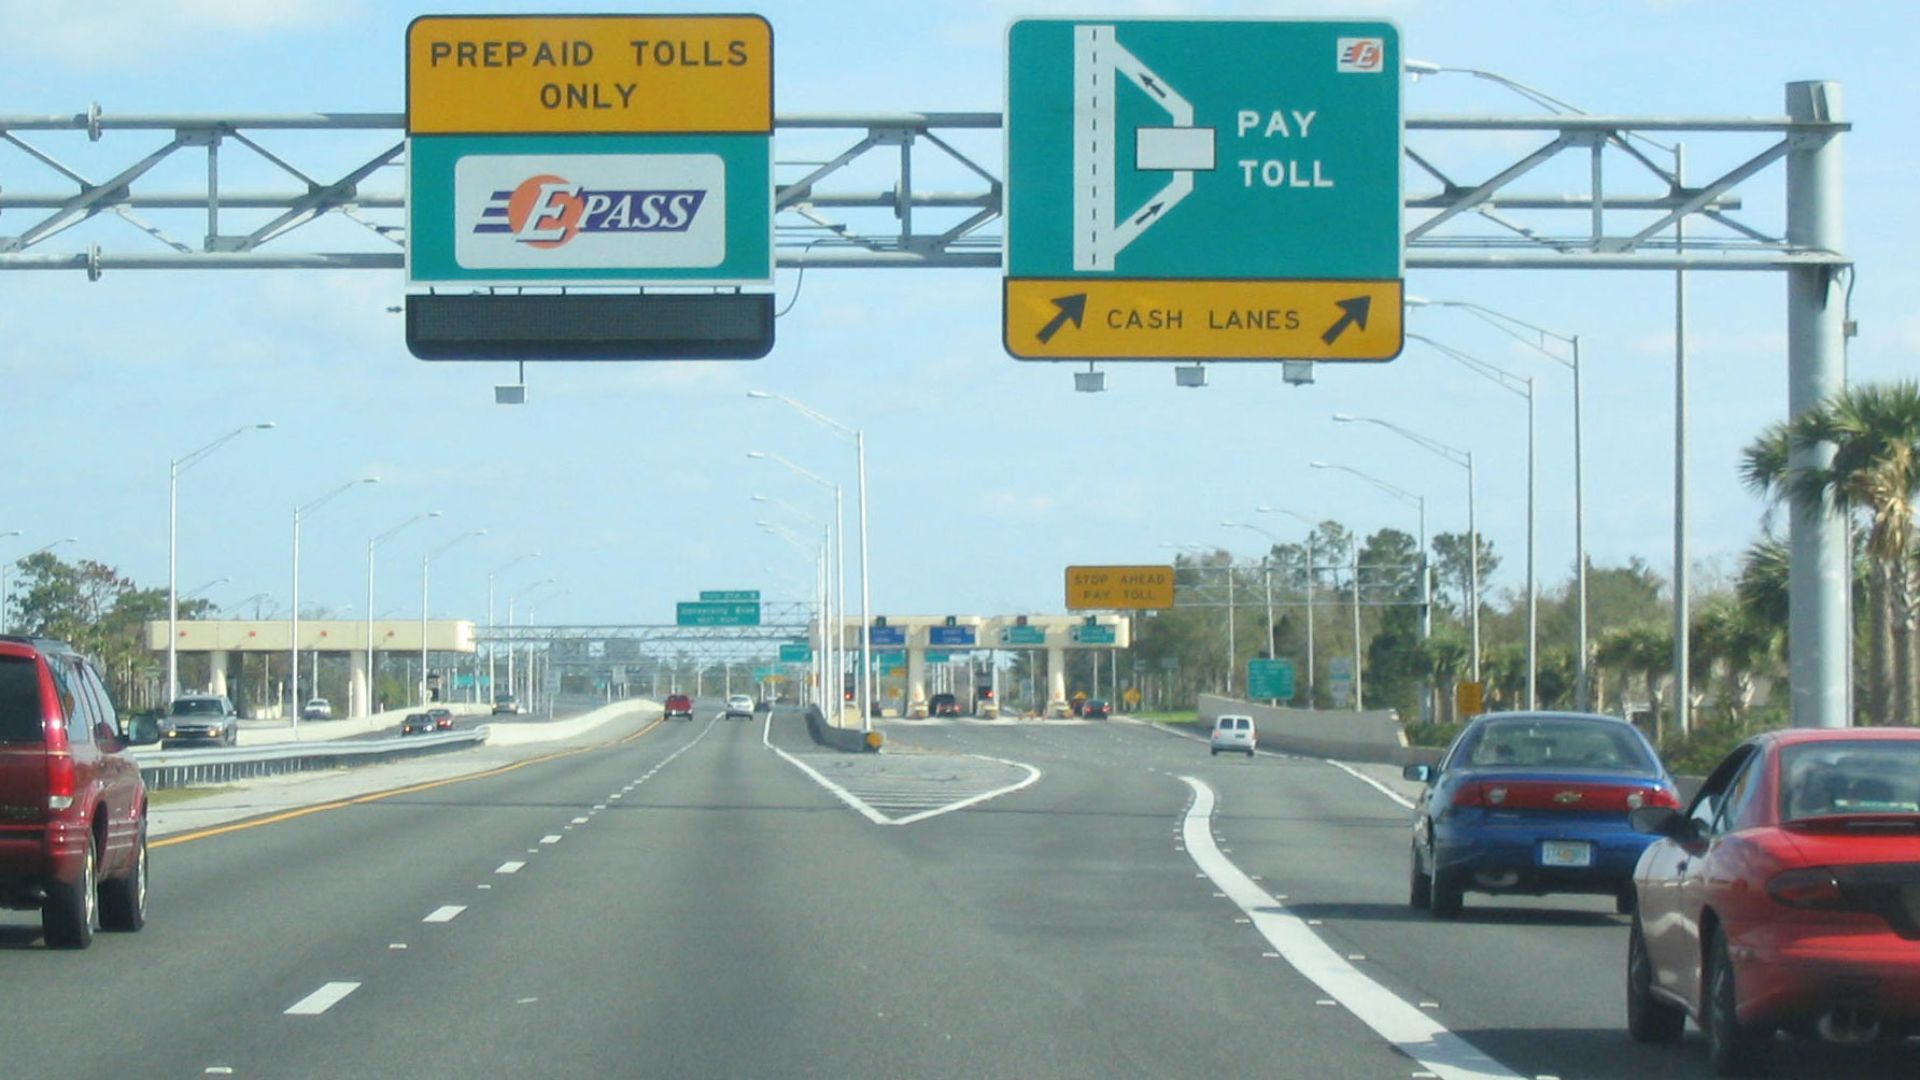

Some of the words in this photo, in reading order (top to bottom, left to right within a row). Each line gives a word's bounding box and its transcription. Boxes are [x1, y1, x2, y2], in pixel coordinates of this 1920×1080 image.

[430, 41, 593, 67] PREPAID
[629, 41, 748, 67] TOLLS
[540, 83, 637, 109] ONLY
[1237, 110, 1317, 138] PAY
[1238, 159, 1334, 188] TOLL
[1107, 309, 1183, 329] CASH
[1209, 309, 1300, 330] LANES
[1074, 574, 1108, 584] STOP
[1120, 574, 1165, 584] AHEAD
[1083, 590, 1111, 600] PAY
[1123, 590, 1156, 600] TOLL
